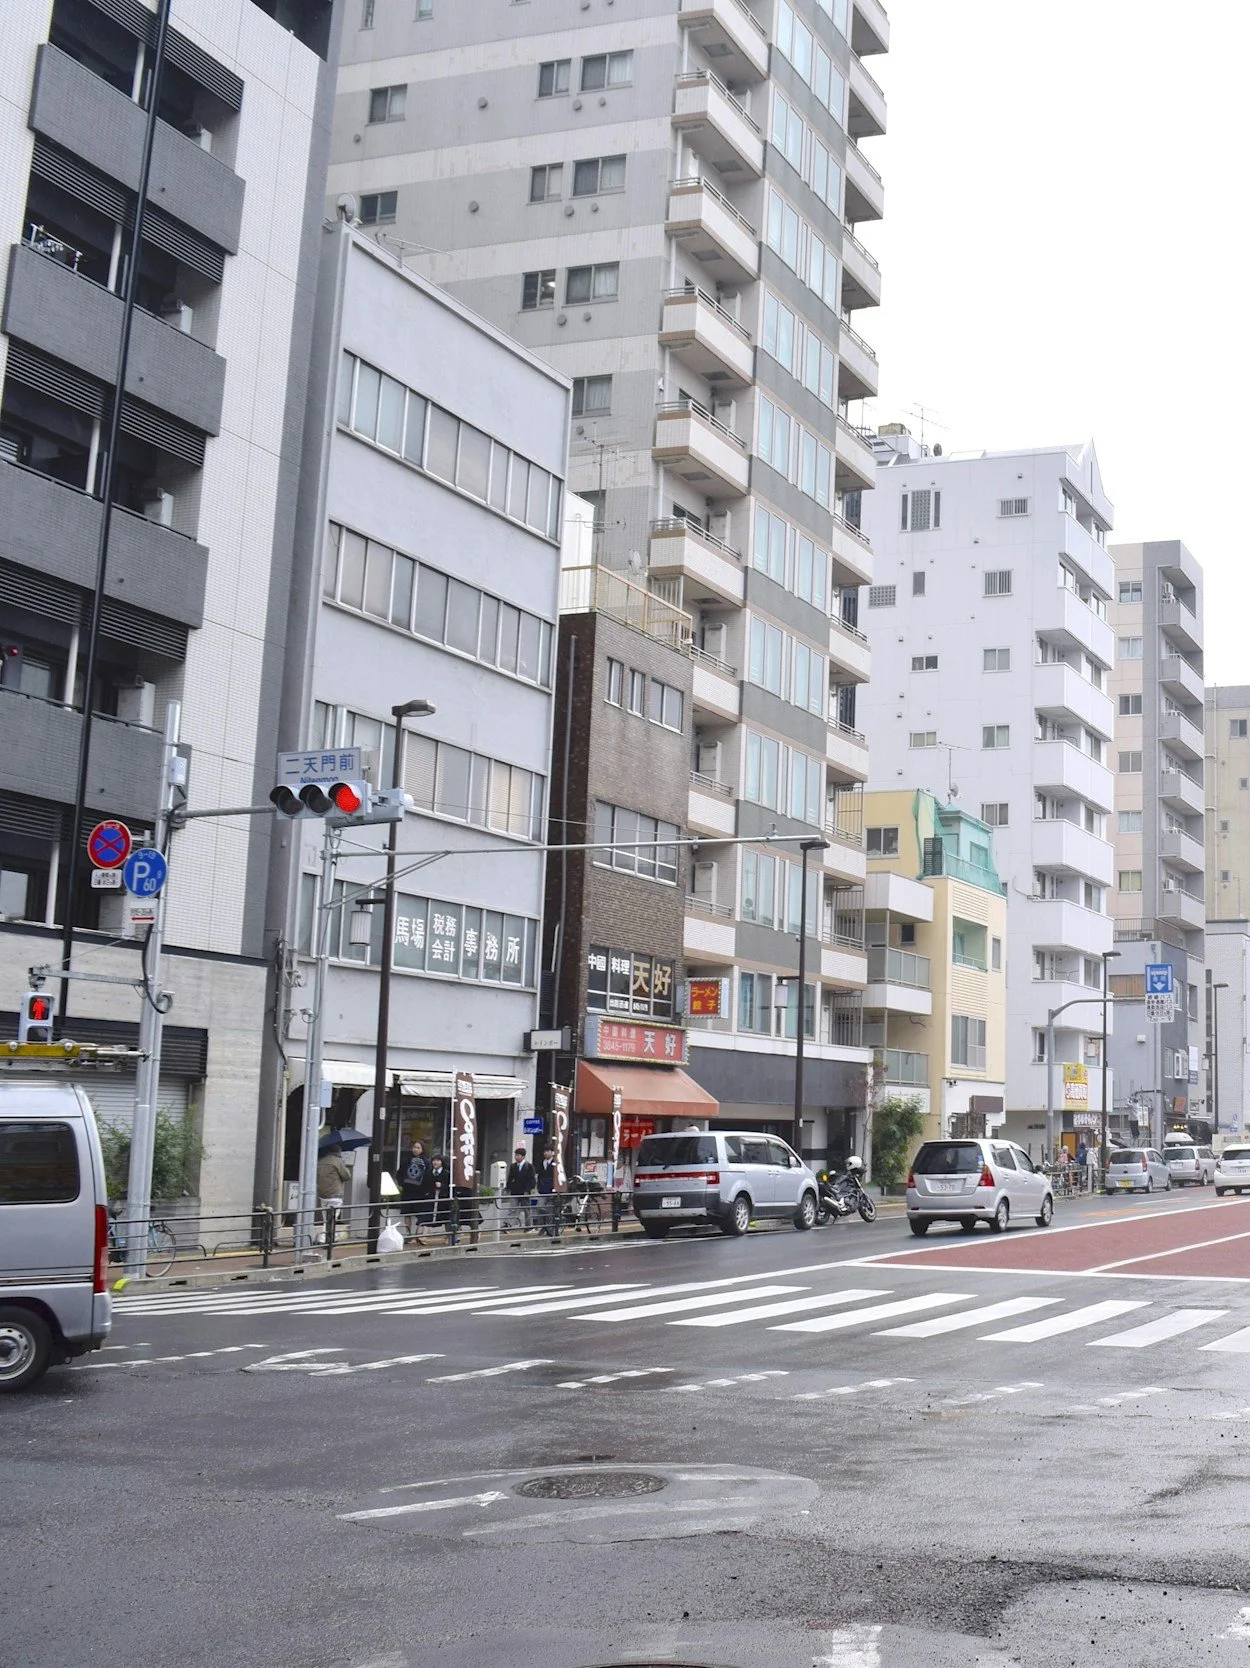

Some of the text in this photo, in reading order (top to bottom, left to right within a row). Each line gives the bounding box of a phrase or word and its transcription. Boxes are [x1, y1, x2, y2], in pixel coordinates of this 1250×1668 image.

[285, 753, 354, 775] 二天門前
[132, 861, 151, 891] P
[143, 878, 156, 891] 60
[394, 915, 425, 949] 馬場
[431, 938, 456, 963] 会計
[464, 927, 520, 964] 事務所
[691, 986, 718, 997] ラーメン
[602, 1040, 636, 1052] 3845-1179
